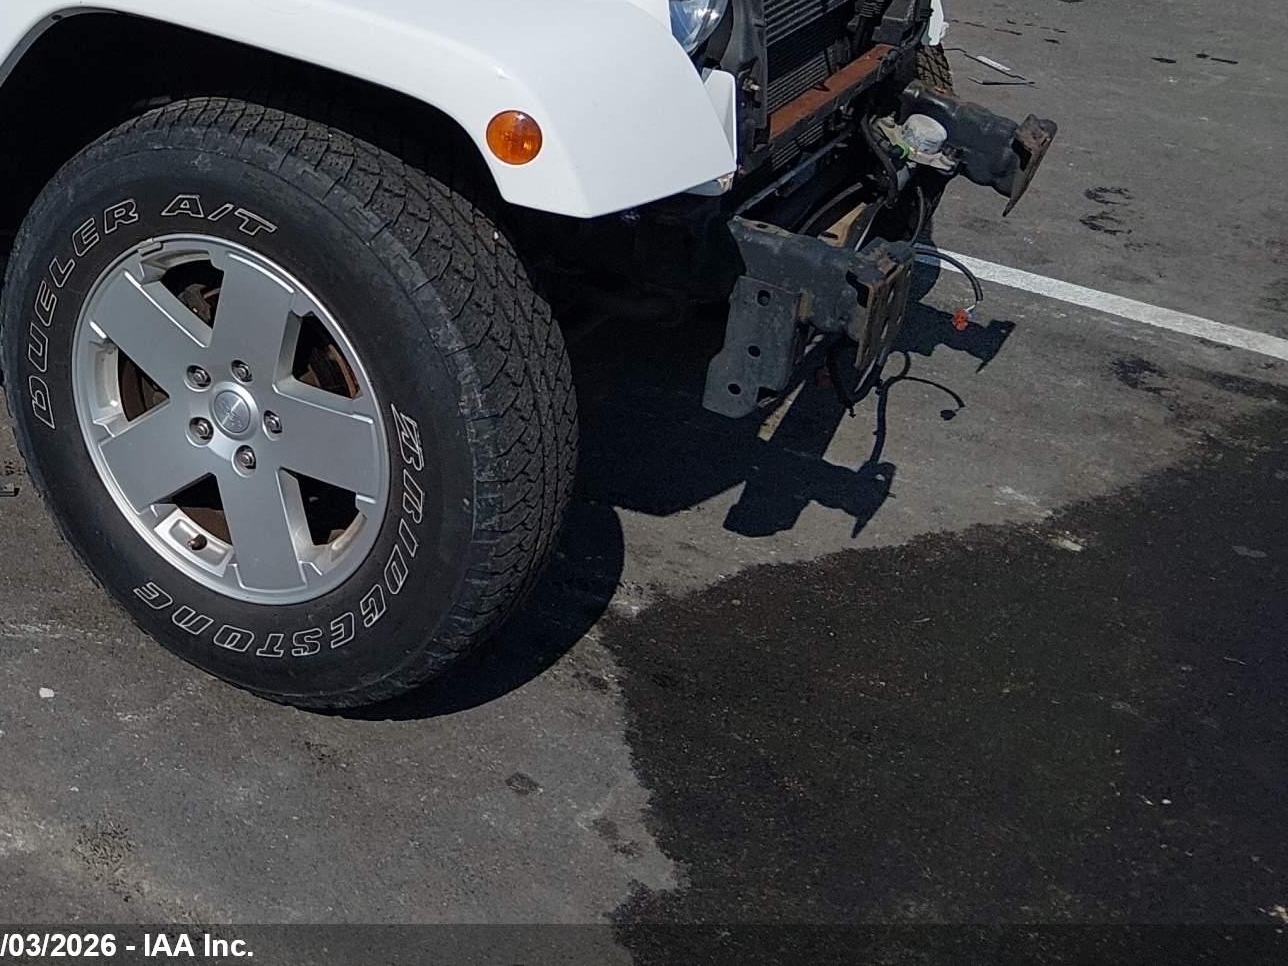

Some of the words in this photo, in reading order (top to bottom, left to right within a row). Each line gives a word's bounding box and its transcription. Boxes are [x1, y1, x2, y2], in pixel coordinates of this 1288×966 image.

[27, 198, 140, 430] DUELER
[160, 194, 278, 237] A/T
[132, 403, 425, 659] BRIDGESTONE
